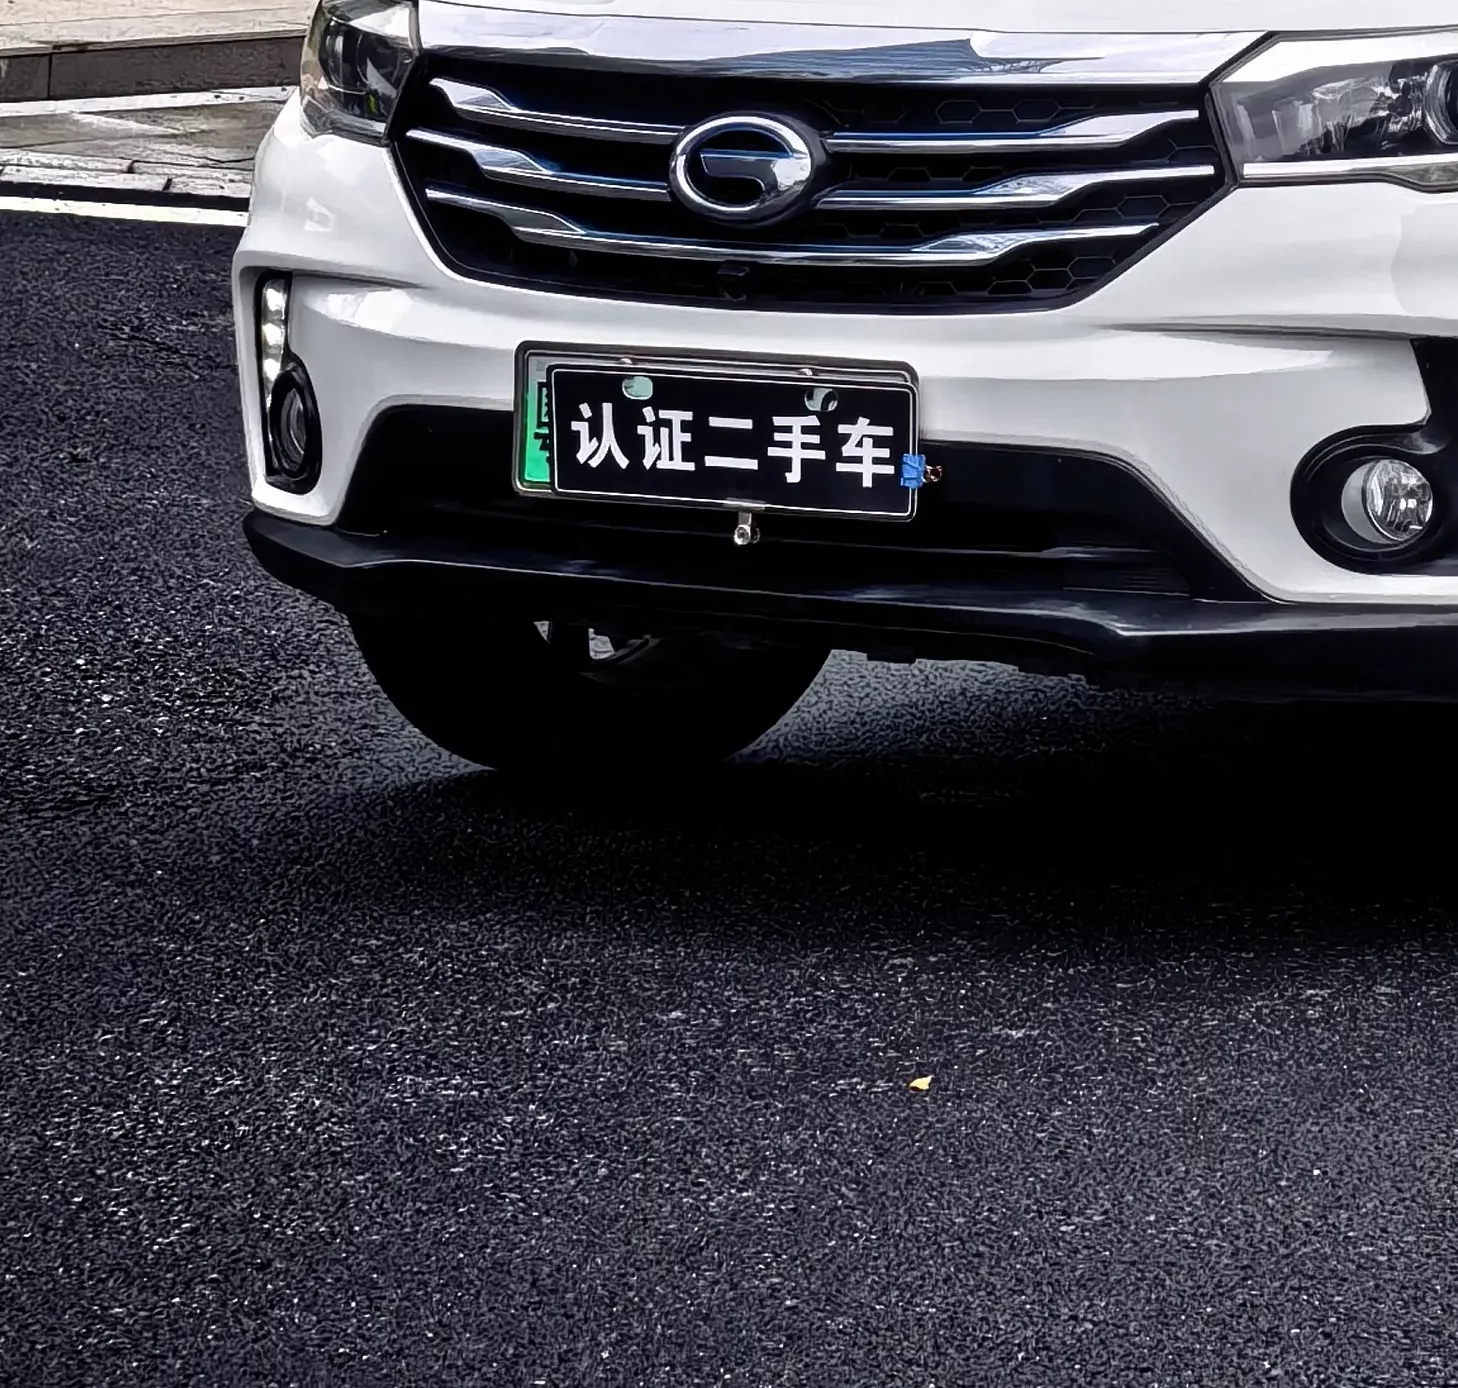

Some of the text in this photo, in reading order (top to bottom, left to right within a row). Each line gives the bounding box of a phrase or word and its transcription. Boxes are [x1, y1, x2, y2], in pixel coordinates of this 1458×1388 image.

[571, 402, 895, 488] 认证二手车
